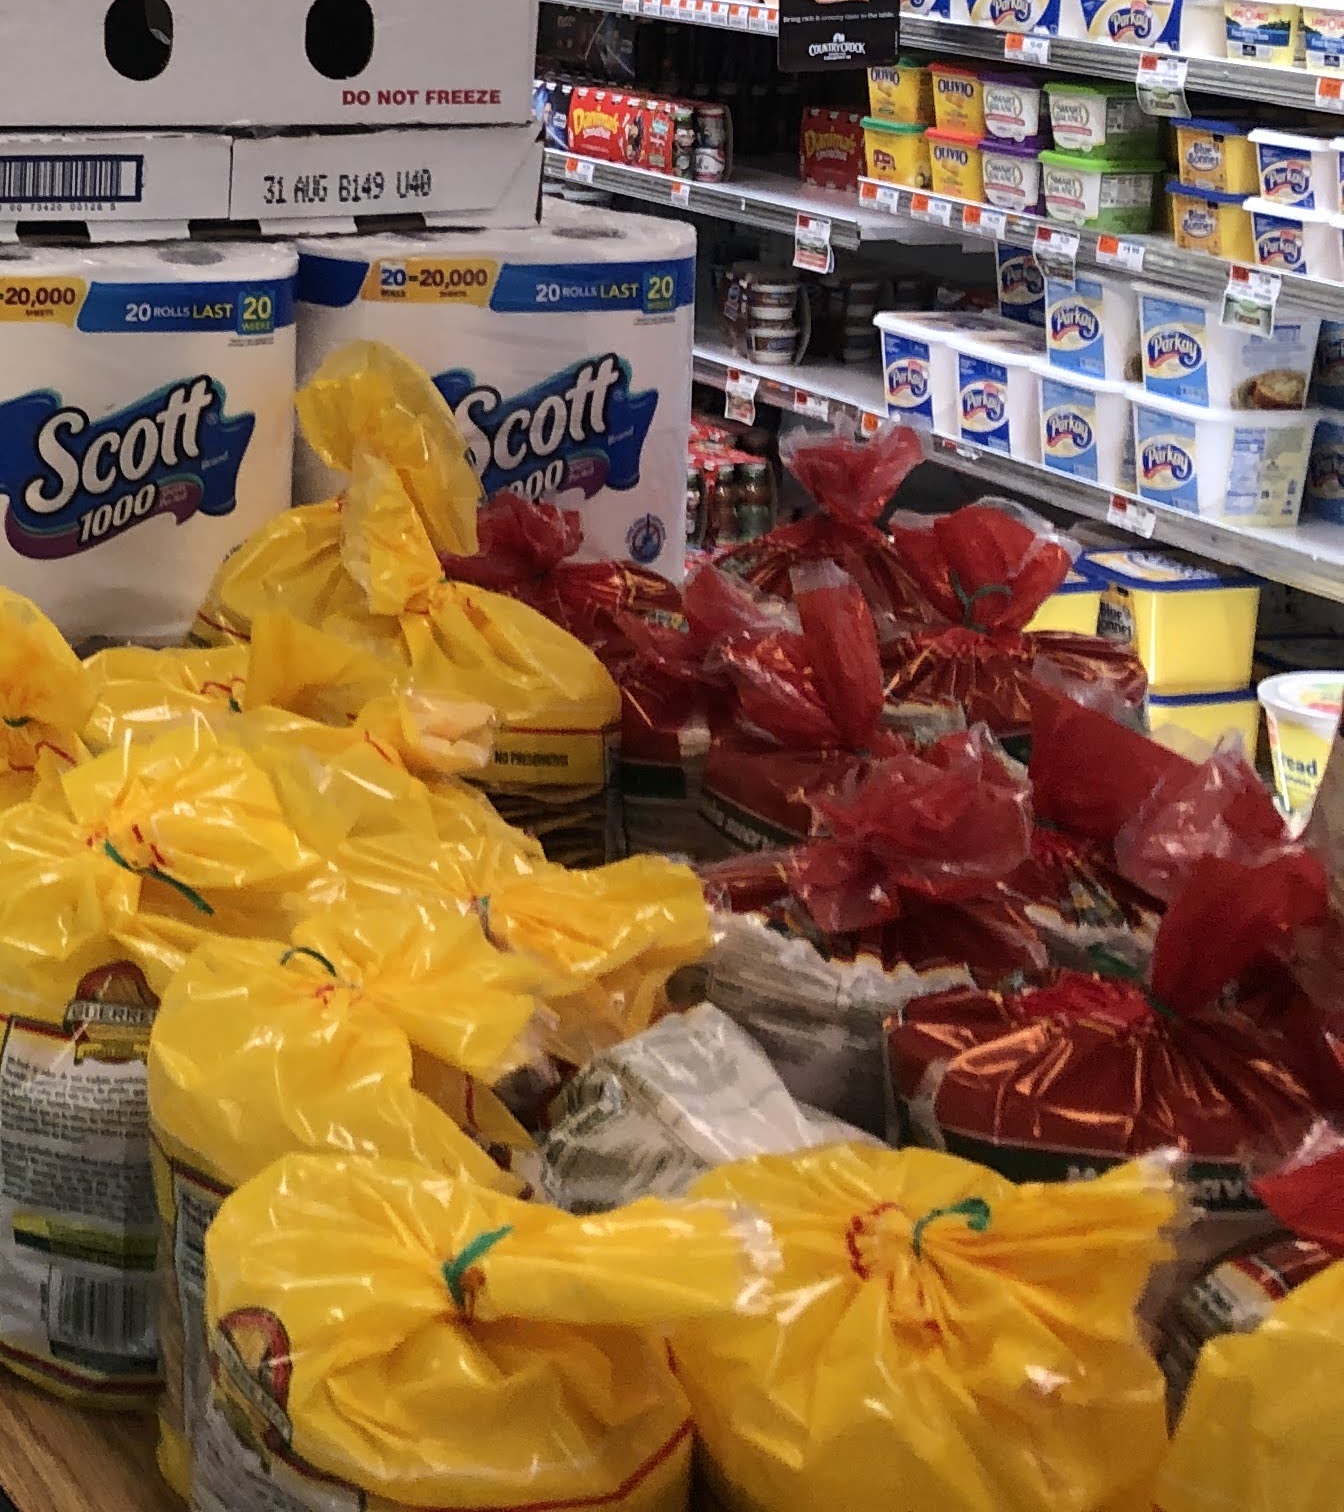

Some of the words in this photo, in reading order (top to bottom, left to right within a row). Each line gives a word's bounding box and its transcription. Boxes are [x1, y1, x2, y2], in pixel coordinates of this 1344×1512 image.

[1111, 11, 1150, 36] Parkay
[808, 41, 841, 56] COUNTRY
[870, 67, 900, 86] OLIVIO
[937, 77, 975, 99] OLIVIO
[341, 89, 371, 106] DO
[377, 89, 420, 106] NOT
[424, 88, 502, 106] FREEZE
[1056, 103, 1083, 117] SMART
[933, 144, 969, 166] OLIVIO
[1186, 151, 1220, 166] Bonnet
[1193, 141, 1212, 154] Blue
[262, 174, 287, 205] 31
[293, 173, 329, 203] AUG
[1049, 175, 1077, 188] SMART
[1265, 167, 1307, 190] Parkay
[1182, 219, 1214, 233] Bonnet
[1188, 209, 1207, 221] Blue
[1261, 236, 1301, 260] Parkay
[380, 289, 407, 299] ROLLS
[535, 283, 562, 303] 20
[562, 286, 598, 299] ROLLS
[599, 283, 640, 299] LAST
[647, 274, 675, 300] 20
[124, 302, 152, 323] 20
[153, 305, 191, 319] ROLLS
[192, 303, 235, 319] LAST
[243, 295, 272, 320] 20
[1054, 303, 1098, 339] Parkay
[1150, 330, 1201, 368] Parkay
[888, 365, 928, 395] Parkay
[454, 354, 621, 476] Scott
[963, 386, 1006, 420] Parkay
[1046, 411, 1092, 447] Parkay
[23, 374, 214, 515] Scott
[1144, 441, 1192, 481] Parkay
[76, 482, 158, 544] 1000
